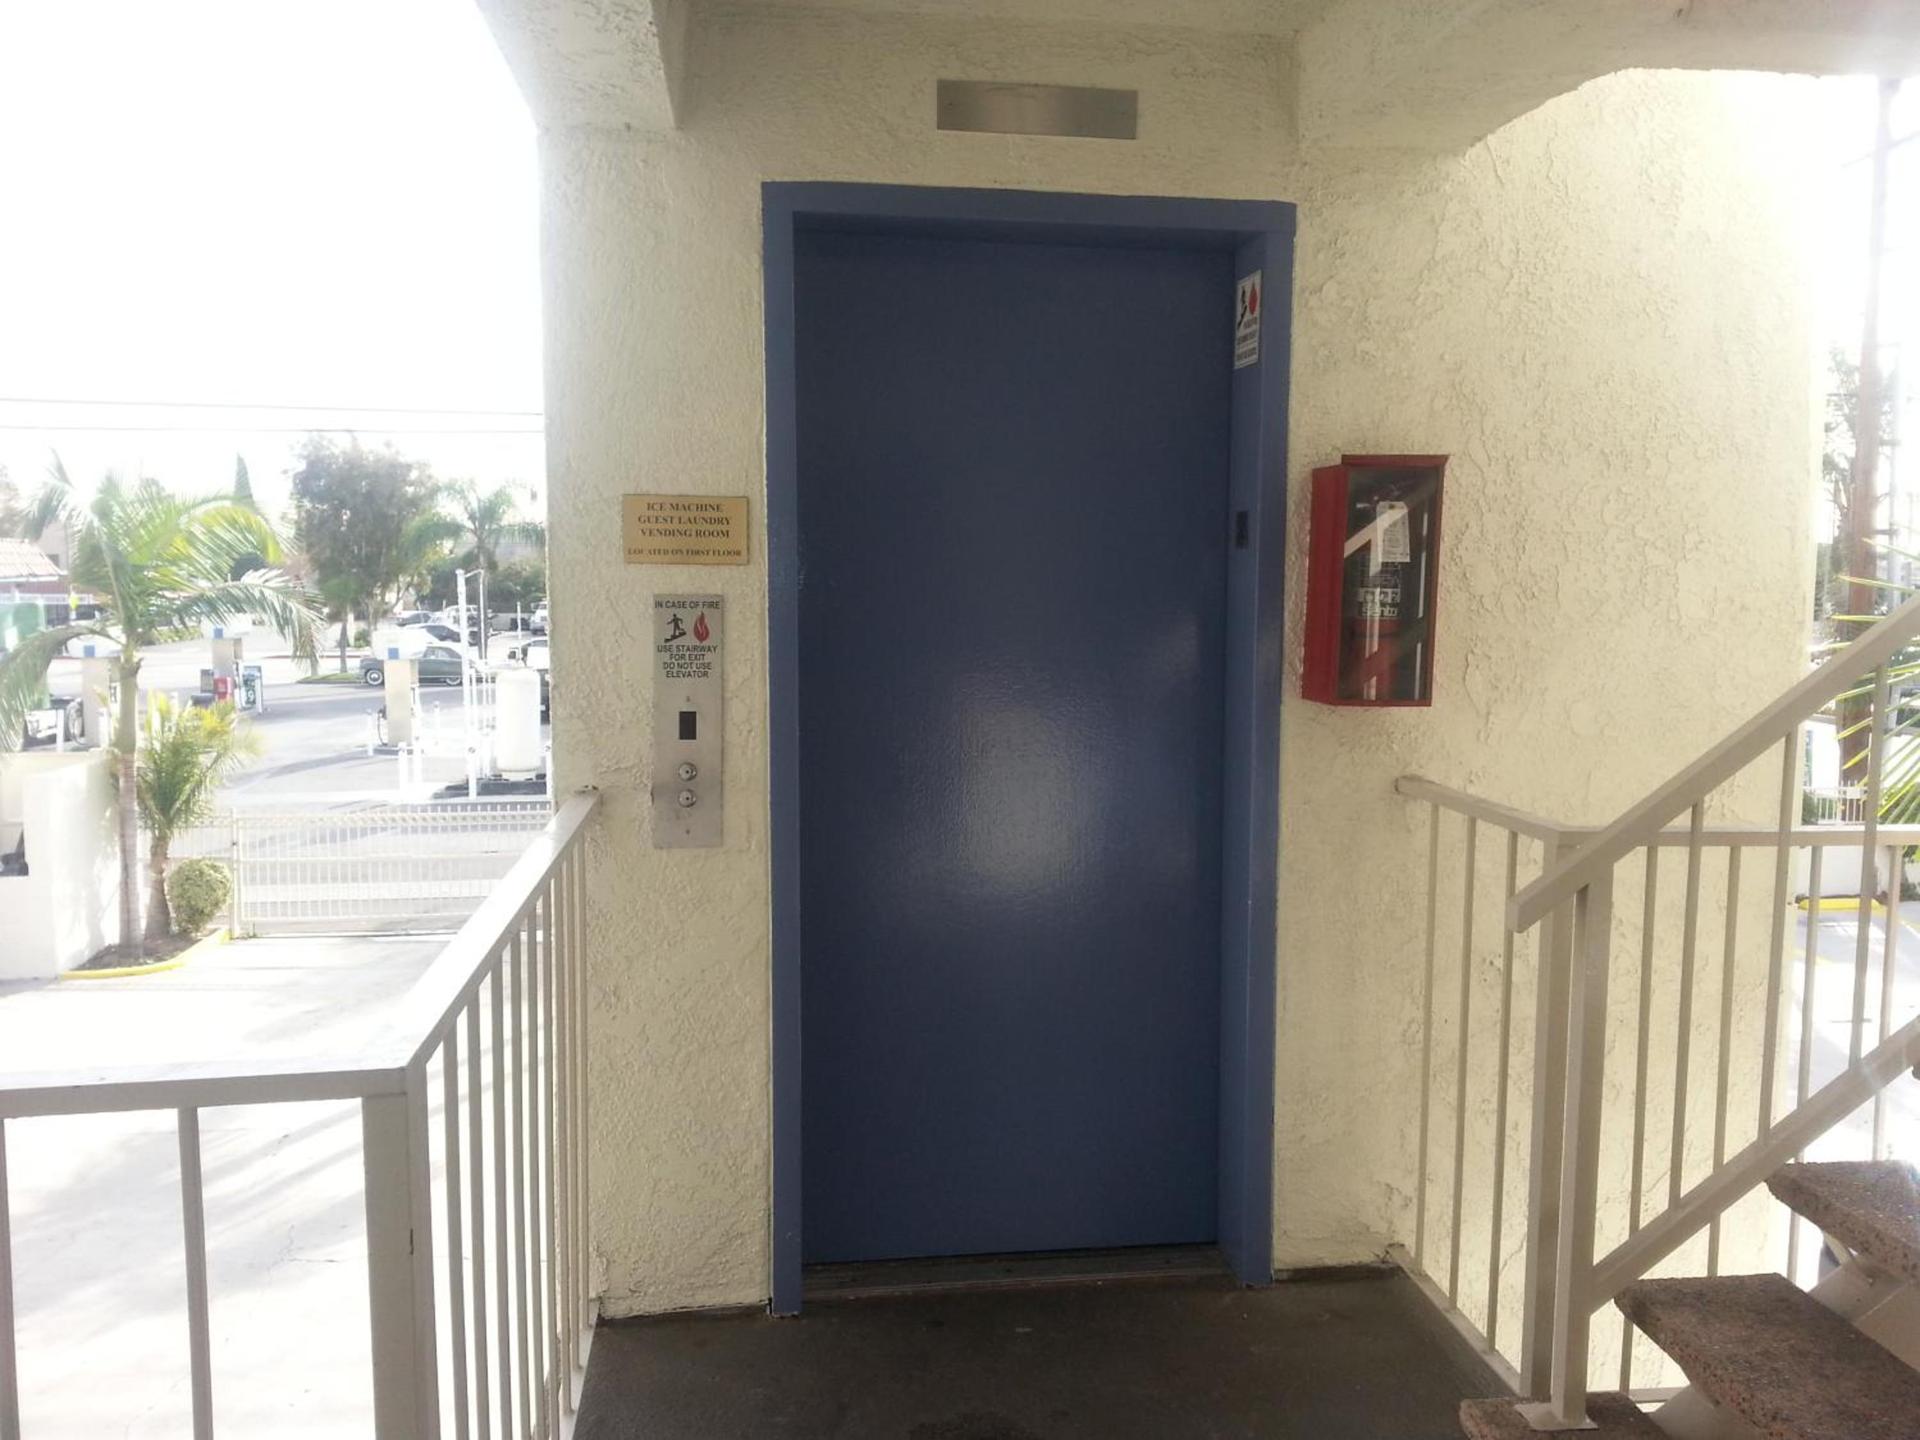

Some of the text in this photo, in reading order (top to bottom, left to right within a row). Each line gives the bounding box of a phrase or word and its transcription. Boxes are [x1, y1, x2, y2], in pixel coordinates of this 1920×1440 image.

[646, 502, 724, 513] ICE MACHINE
[638, 516, 732, 526] GUEST LAUNDRY
[640, 527, 730, 539] VENDING ROOM
[627, 548, 742, 557] LOCATED ON FIRST FLOOR
[655, 600, 721, 609] IN CASE OF FIRE
[657, 645, 718, 653] USE STAIRWAY
[669, 653, 706, 661] FOR EXIT
[663, 662, 712, 670] DO NOT USE
[666, 670, 709, 678] ELEVATOR
